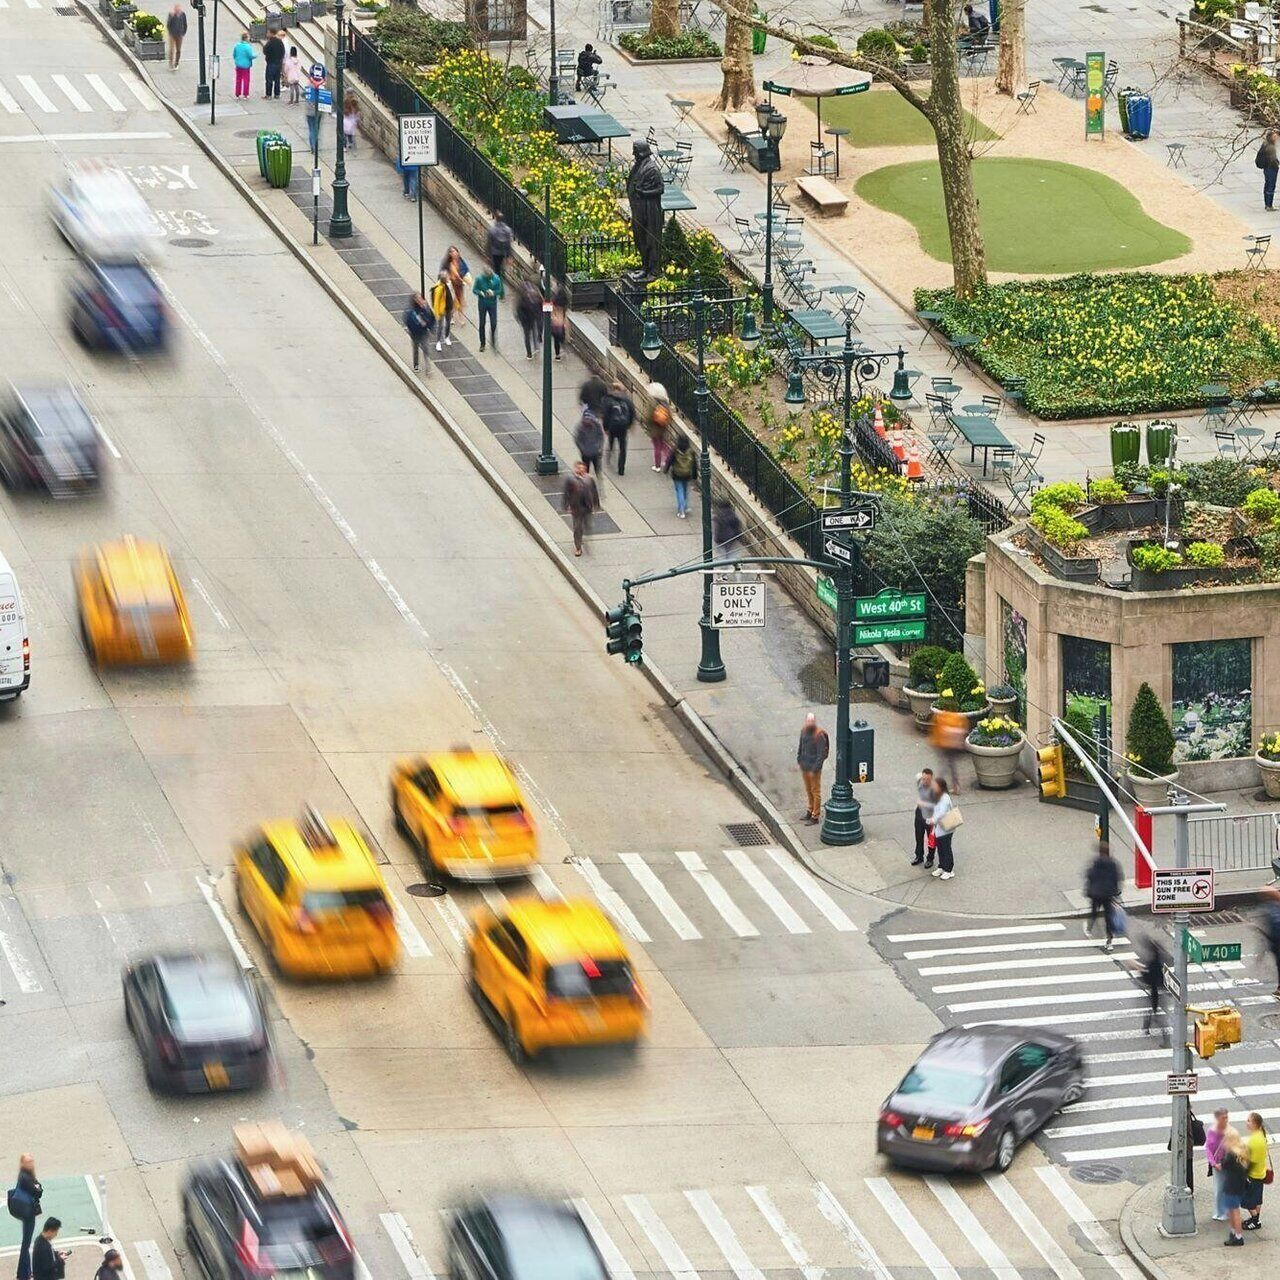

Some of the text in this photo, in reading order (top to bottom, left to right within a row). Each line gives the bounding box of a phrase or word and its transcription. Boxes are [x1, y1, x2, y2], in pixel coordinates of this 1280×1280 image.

[403, 120, 433, 129] BUSES
[407, 135, 429, 145] ONLY
[829, 515, 866, 525] ONE WAY
[720, 586, 757, 597] BUSES
[723, 598, 752, 609] ONLY
[860, 599, 922, 614] West 40th St
[859, 629, 882, 639] Nikola
[883, 627, 901, 637] Tesla
[1201, 947, 1210, 959] W
[1212, 946, 1228, 959] 40
